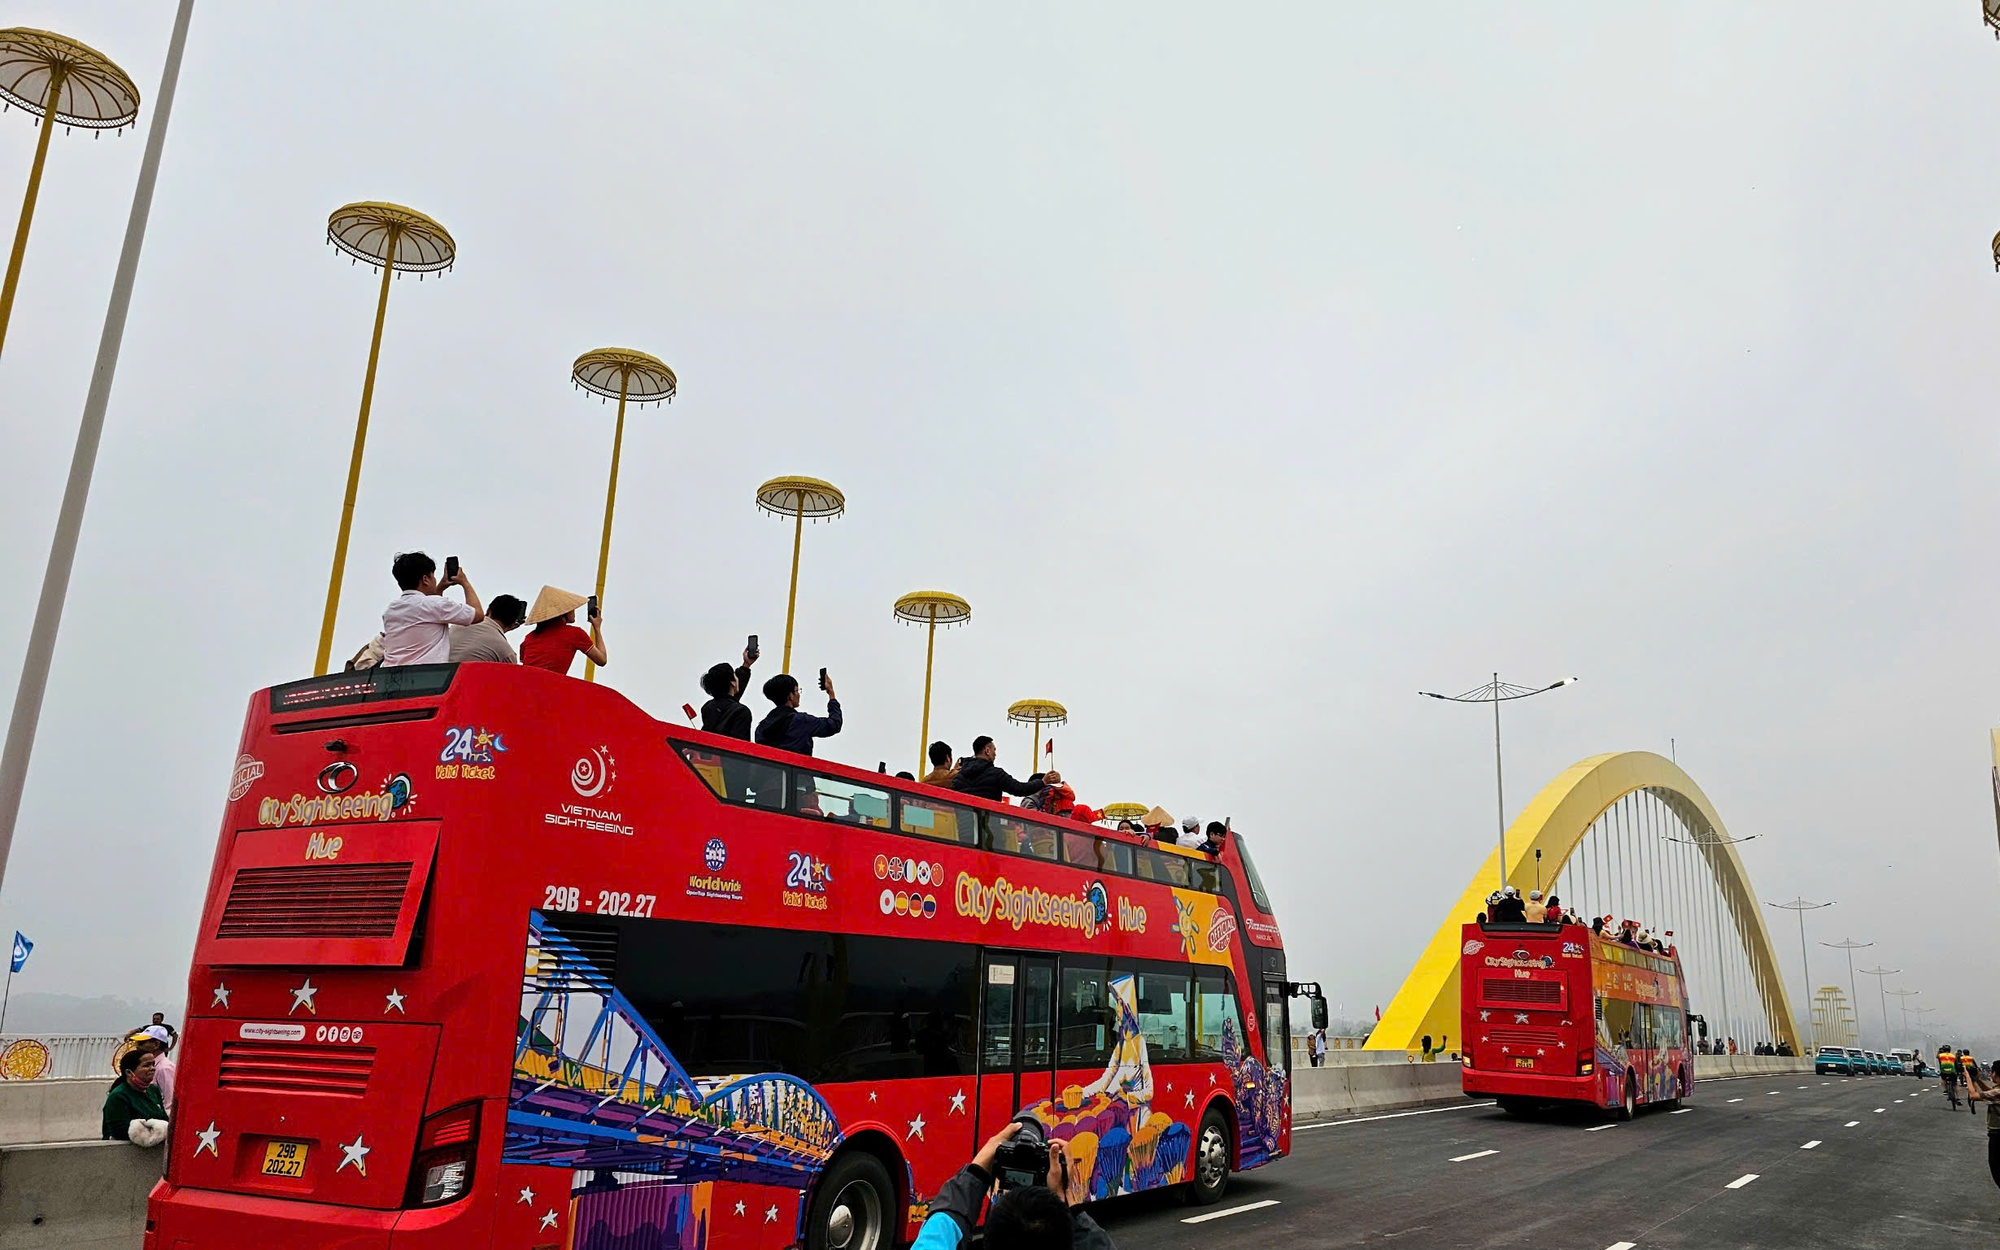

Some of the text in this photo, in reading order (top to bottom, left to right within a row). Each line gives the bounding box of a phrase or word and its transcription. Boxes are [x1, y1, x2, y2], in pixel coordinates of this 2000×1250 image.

[440, 726, 474, 763] 24
[436, 764, 496, 780] Valid Ticket
[561, 803, 622, 822] VIETNAM
[545, 814, 634, 836] SIGHTSEEING
[305, 832, 343, 860] Hue
[786, 852, 811, 888] 24
[689, 875, 742, 892] Worldwide
[542, 885, 579, 912] 29B
[597, 890, 656, 918] 202.27
[782, 891, 828, 911] Valid Ticket
[1118, 895, 1146, 934] Hue
[1210, 918, 1235, 945] OFFICIAL
[1562, 941, 1574, 954] 24
[277, 1144, 297, 1158] 29B
[266, 1159, 300, 1175] 202.27
